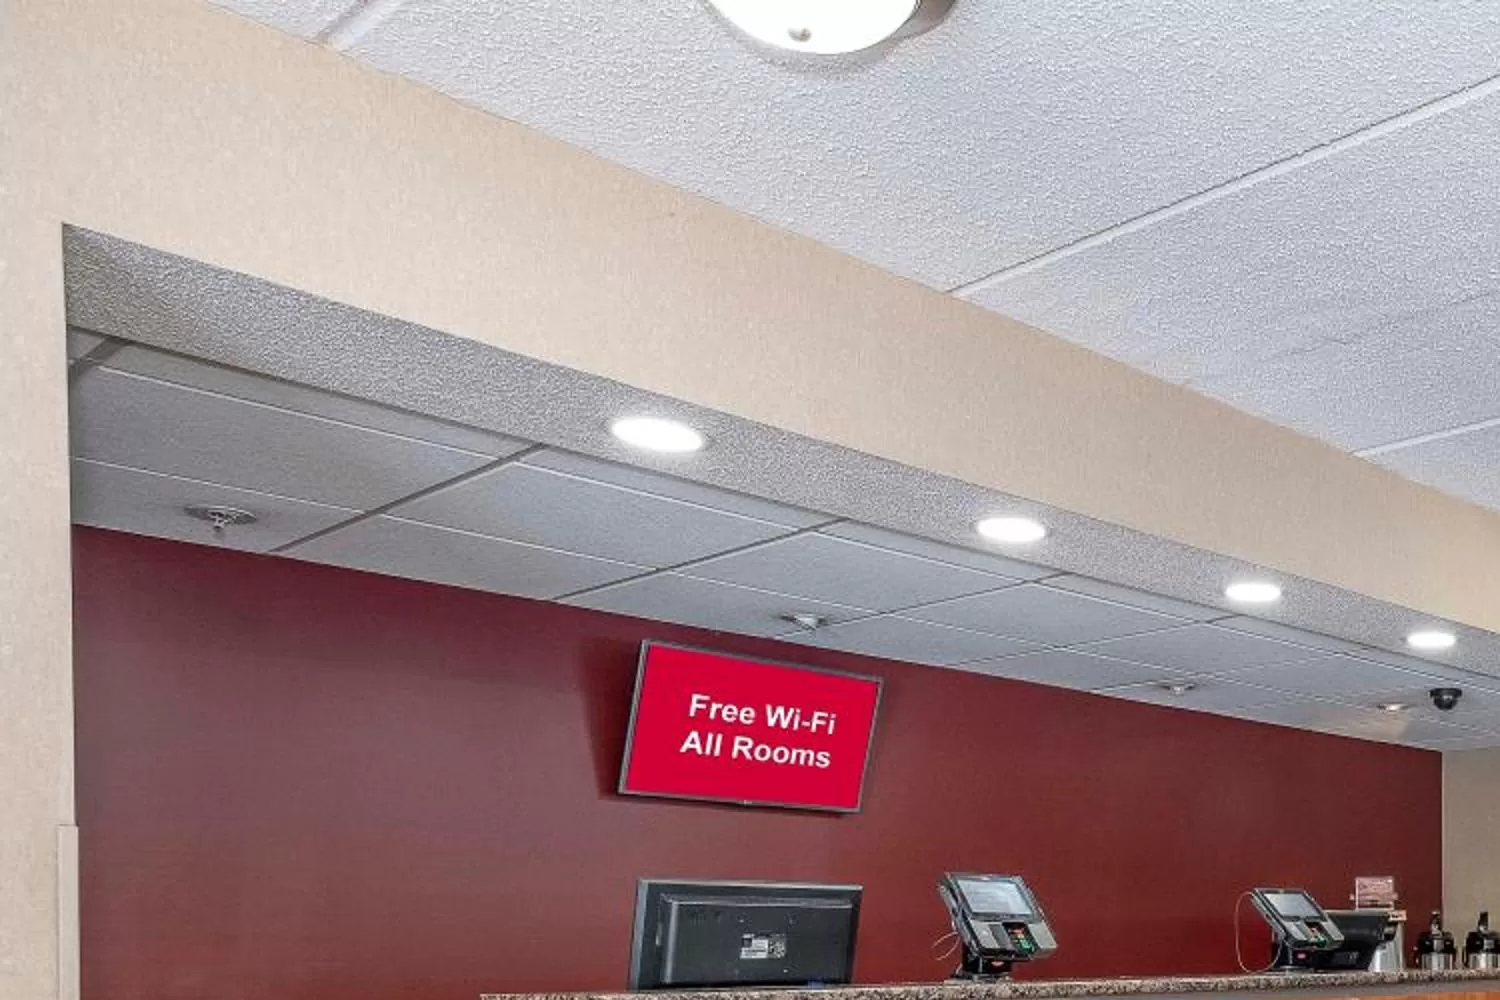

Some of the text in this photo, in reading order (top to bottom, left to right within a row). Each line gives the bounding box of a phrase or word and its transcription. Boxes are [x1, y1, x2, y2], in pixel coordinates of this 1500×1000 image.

[689, 693, 836, 735] Free Wi-Fi
[679, 730, 831, 769] All Rooms
